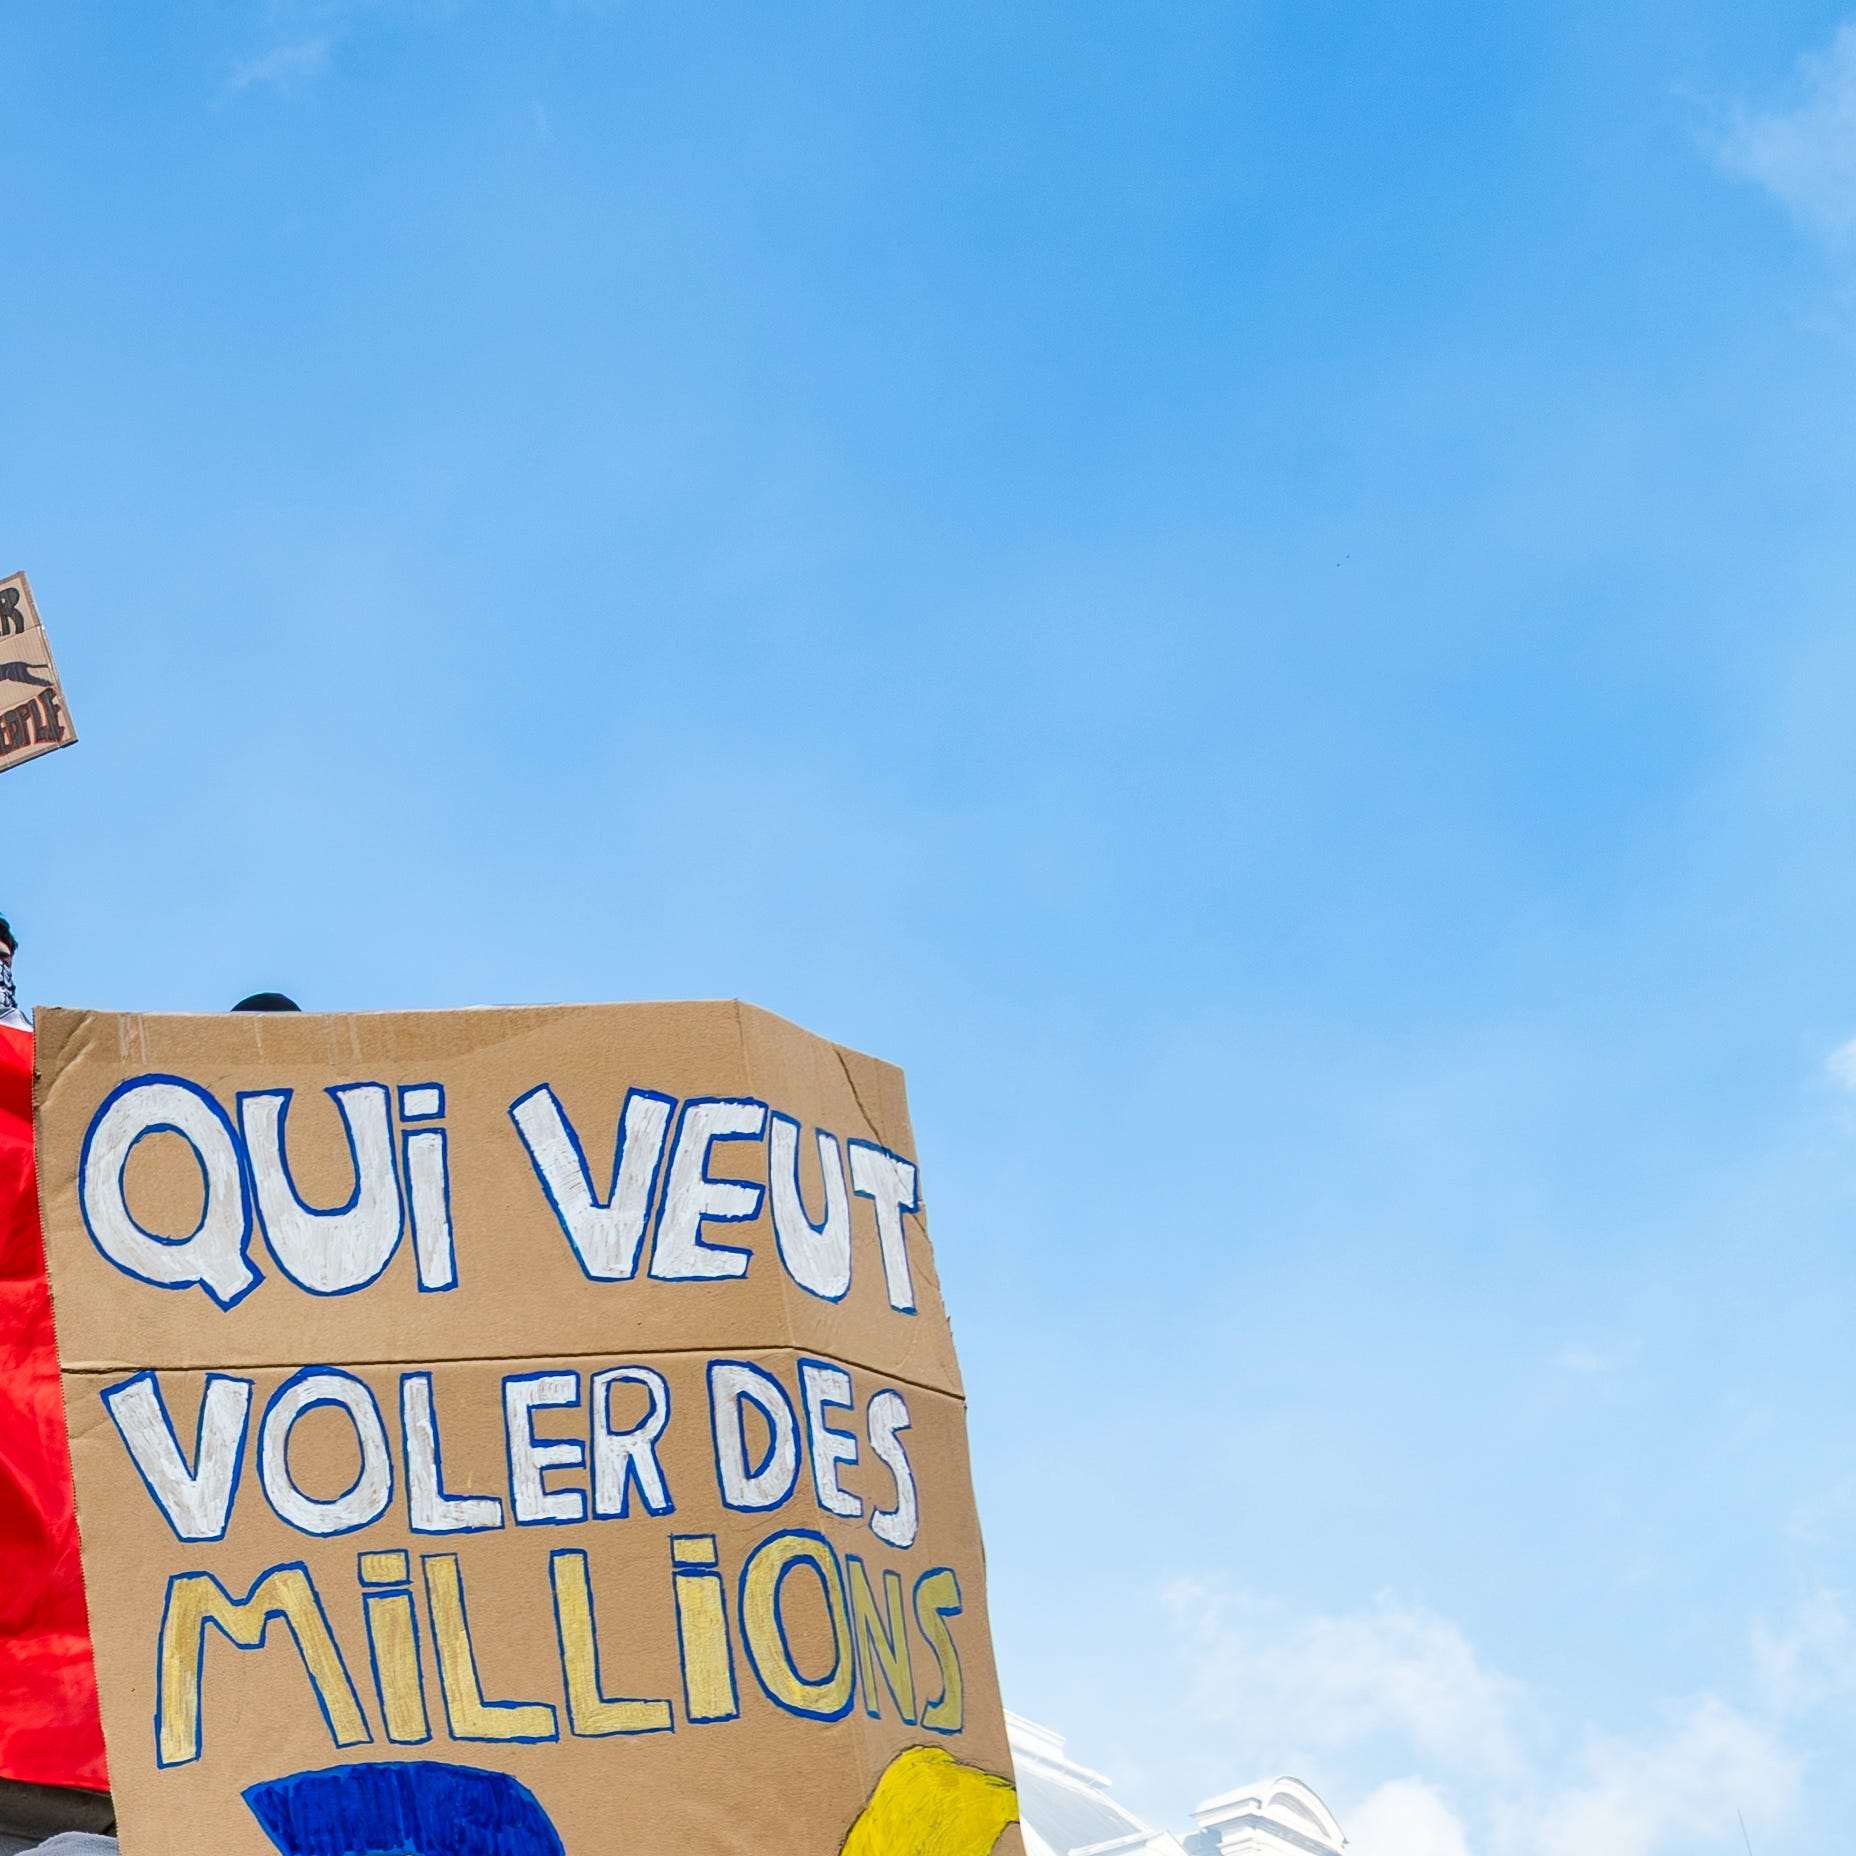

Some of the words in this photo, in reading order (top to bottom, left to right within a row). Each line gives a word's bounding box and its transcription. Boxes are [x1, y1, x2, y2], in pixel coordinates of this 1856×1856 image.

[507, 1081, 922, 1316] VEUT
[100, 1362, 674, 1544] VOLER
[705, 1357, 918, 1550] DES
